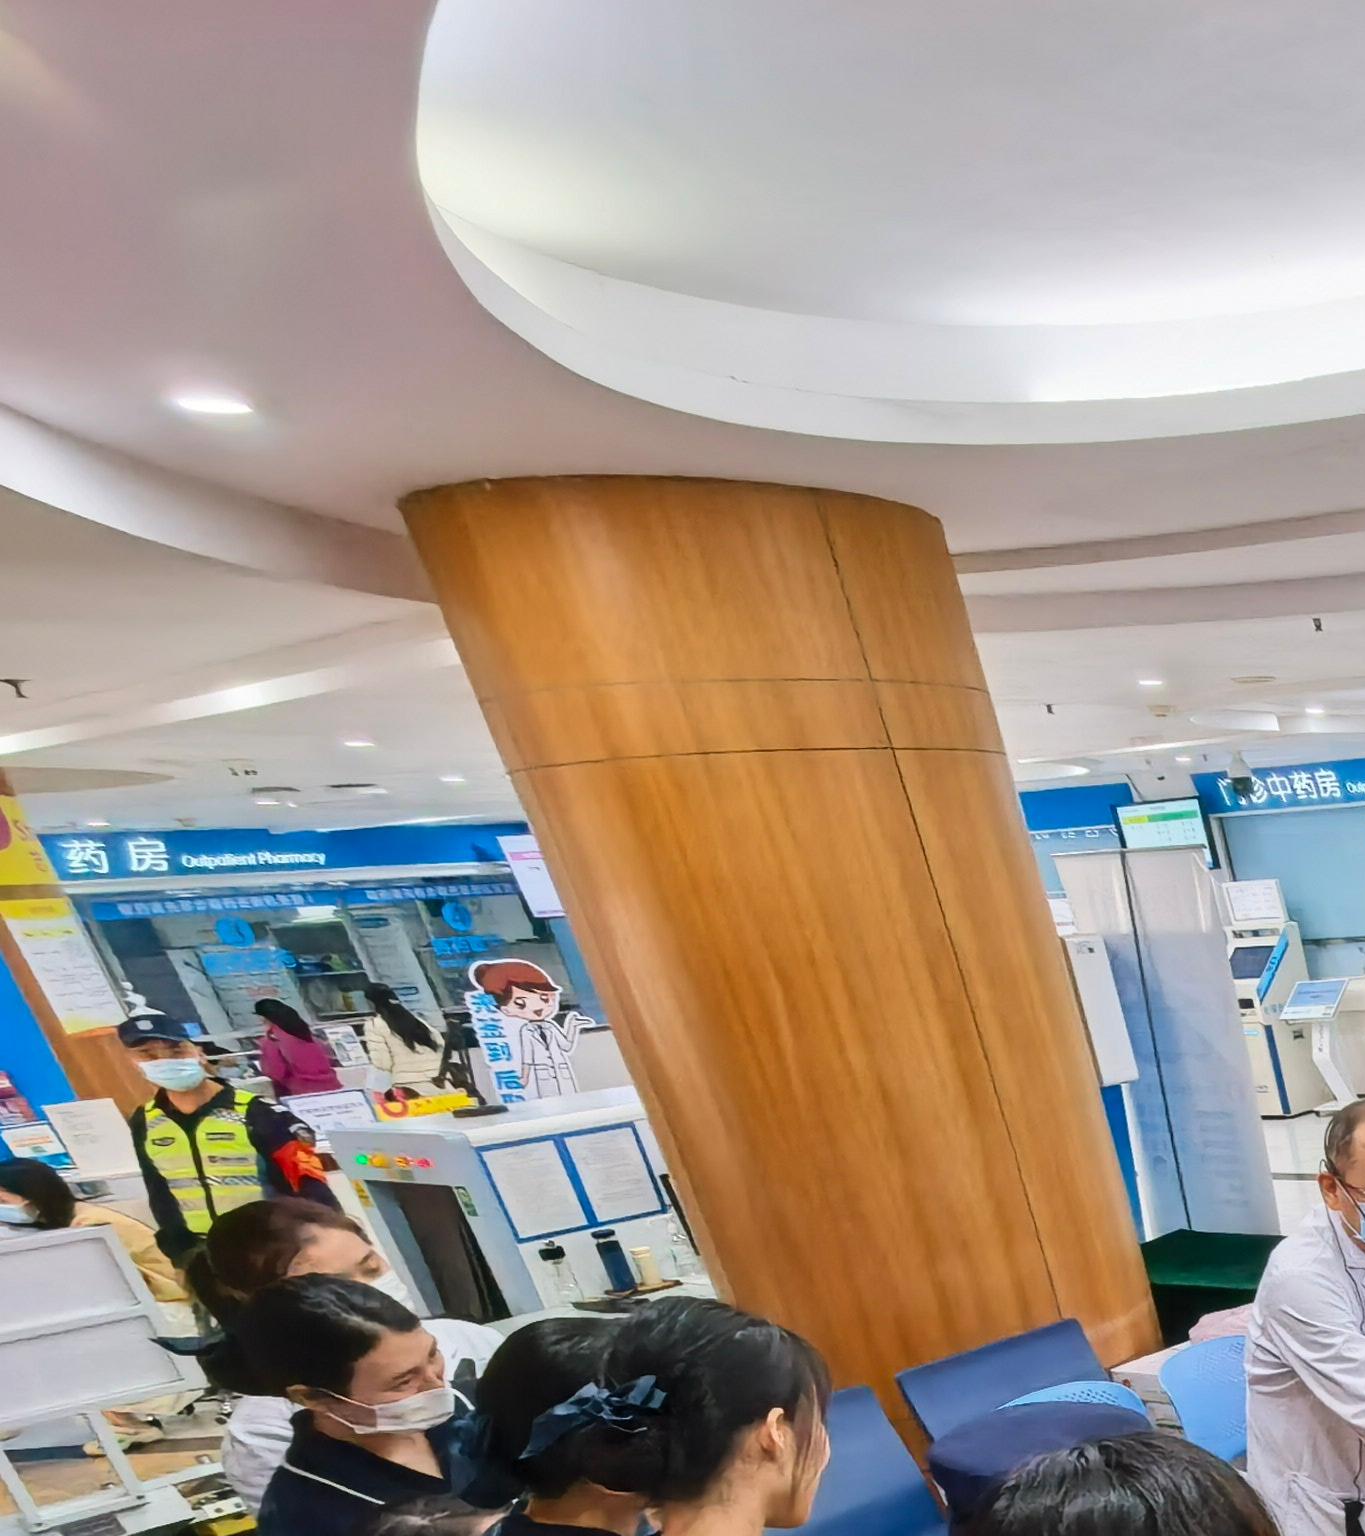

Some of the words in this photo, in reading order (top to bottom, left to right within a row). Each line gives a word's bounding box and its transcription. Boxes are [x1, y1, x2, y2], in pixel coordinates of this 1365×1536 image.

[60, 837, 170, 875] 药房
[181, 852, 256, 869] Outpatient
[257, 850, 326, 866] Pharmacy
